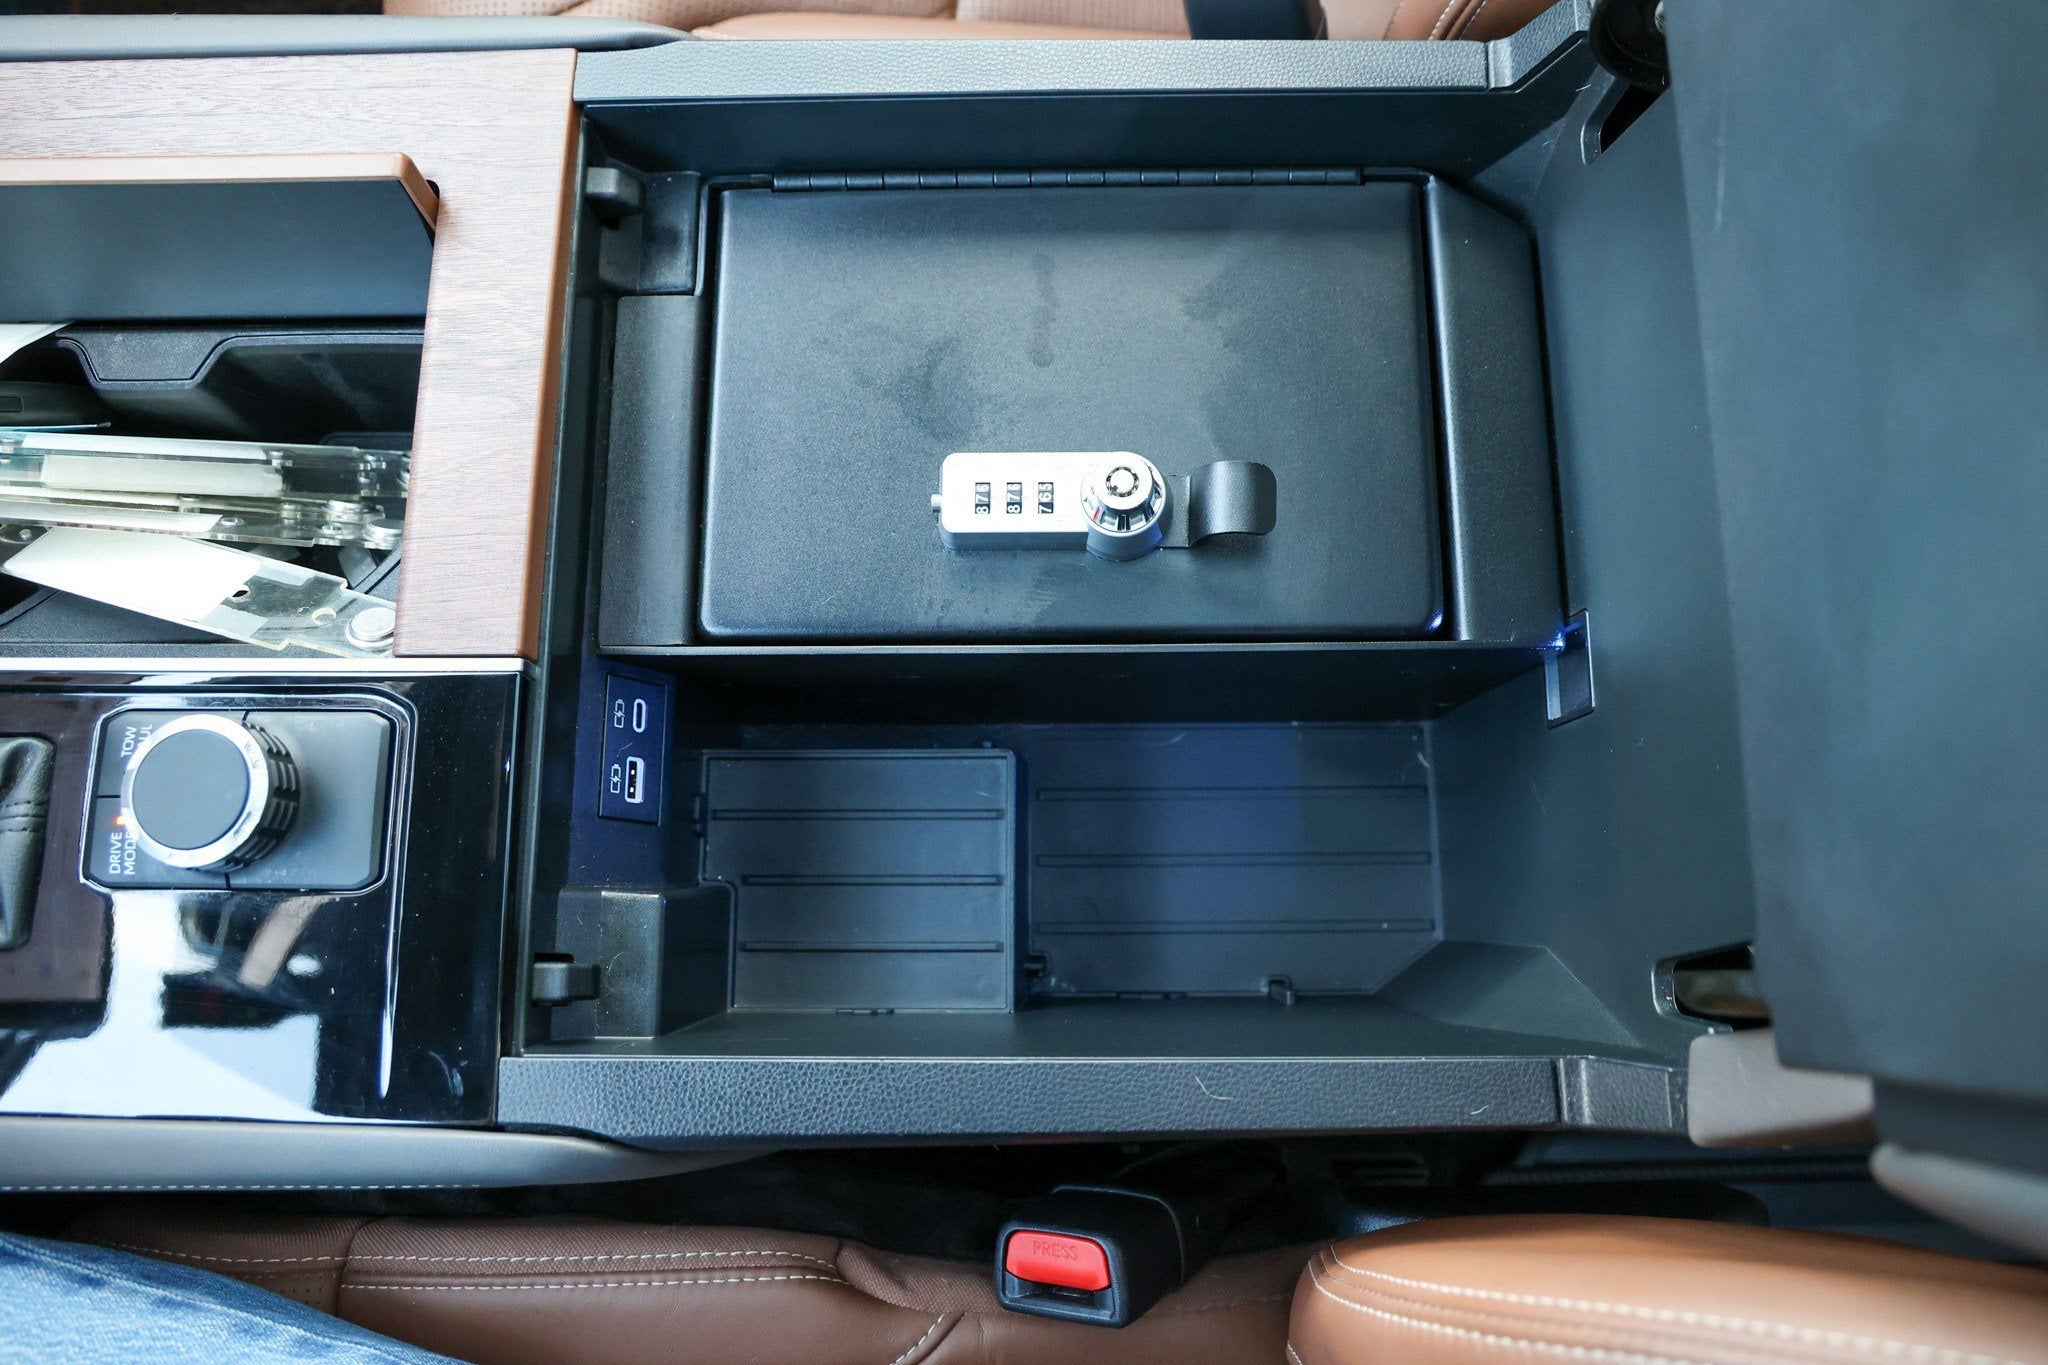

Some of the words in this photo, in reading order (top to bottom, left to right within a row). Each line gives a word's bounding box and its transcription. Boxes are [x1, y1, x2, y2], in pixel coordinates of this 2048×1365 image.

[121, 726, 138, 758] TOW
[109, 831, 123, 874] DRIVE
[1032, 1240, 1079, 1261] PRESS
